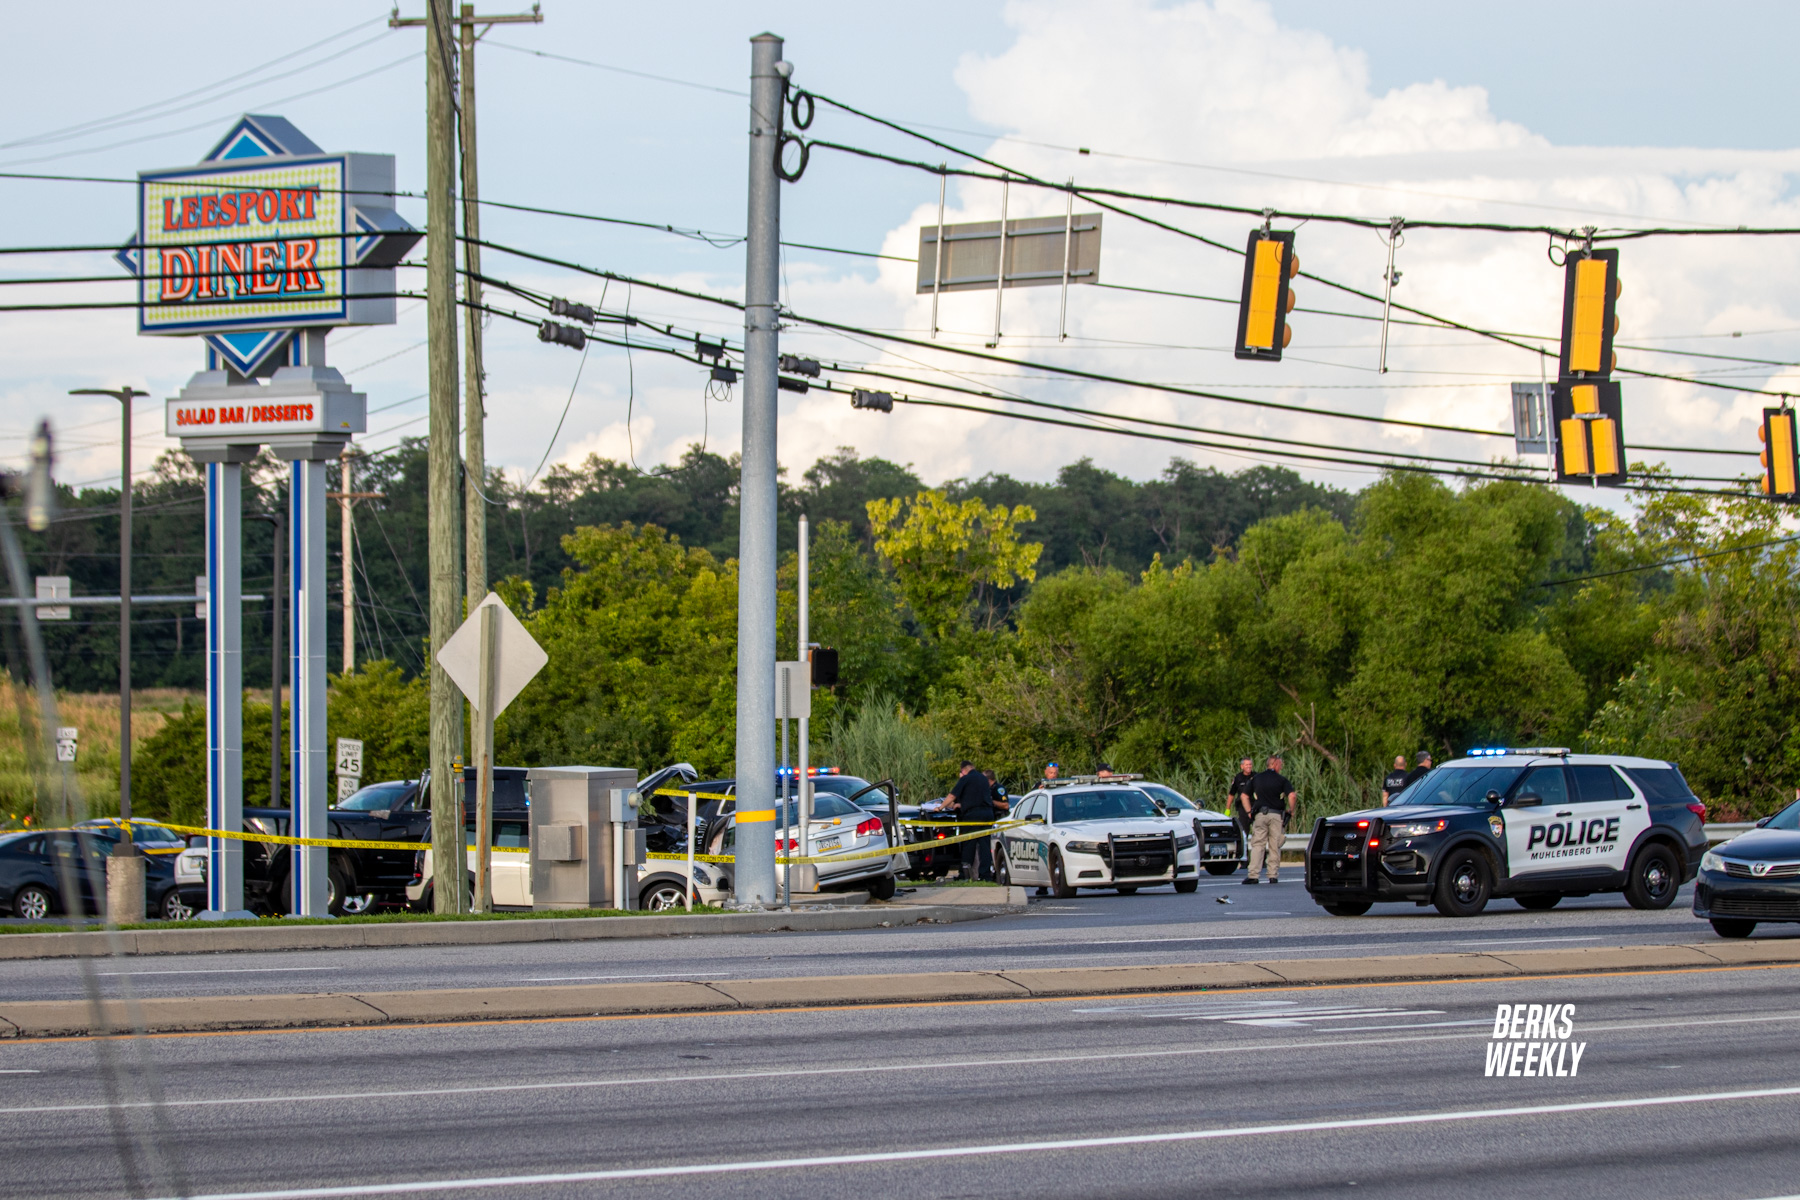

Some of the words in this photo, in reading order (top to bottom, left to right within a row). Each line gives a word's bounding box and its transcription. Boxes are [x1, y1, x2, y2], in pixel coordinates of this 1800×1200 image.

[162, 184, 321, 232] LEESPORT
[159, 239, 324, 301] DINER
[176, 408, 216, 426] SALAD
[59, 744, 74, 758] 73
[340, 743, 361, 751] SPEED
[339, 758, 360, 773] 45
[343, 780, 354, 788] DO
[1386, 778, 1404, 787] POLICE
[1526, 816, 1620, 851] POLICE
[1010, 841, 1039, 861] POLICE
[1531, 846, 1592, 860] MUHLENBERG
[1595, 844, 1614, 854] TWP
